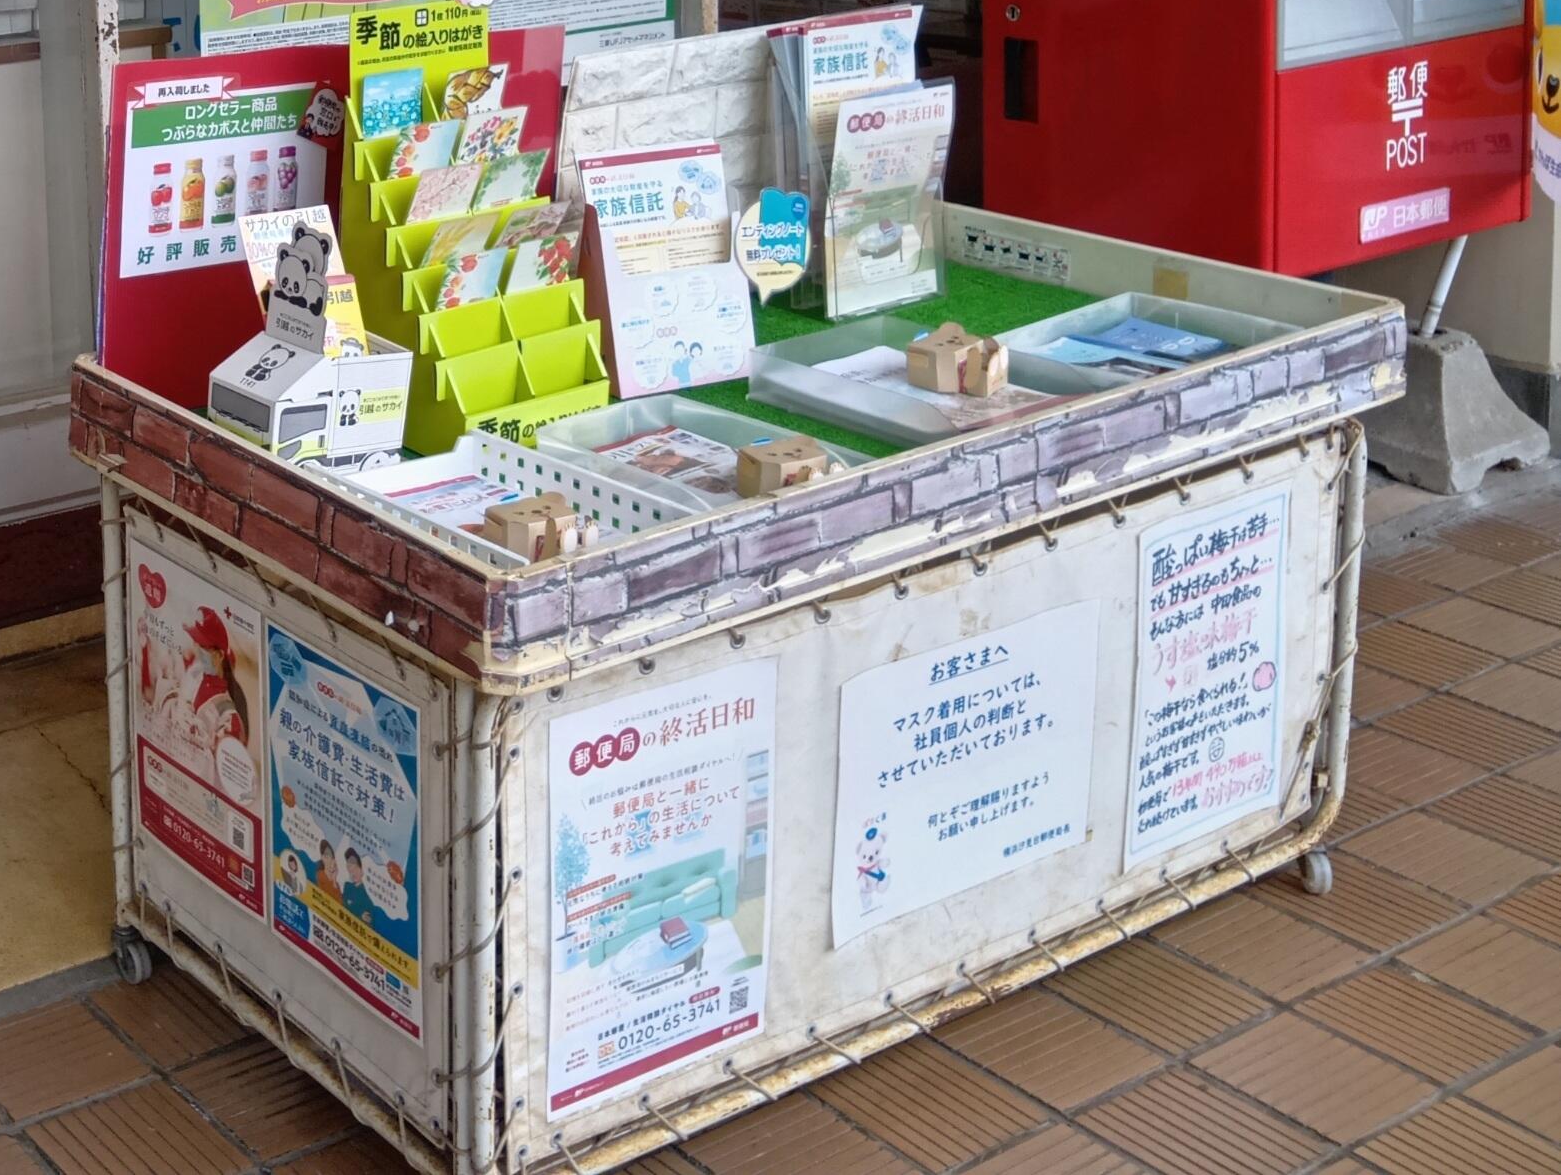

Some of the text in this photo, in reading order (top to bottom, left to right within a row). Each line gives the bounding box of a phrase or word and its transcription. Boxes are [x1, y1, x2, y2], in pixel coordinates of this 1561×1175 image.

[356, 14, 485, 52] 季節の絵入りはがき
[813, 50, 869, 76] 家族信託
[1387, 60, 1429, 105] 郵便
[158, 84, 211, 98] 再入荷しました
[185, 96, 278, 121] ロングセラー商品
[161, 112, 298, 143] つぶらなカボスと仲間たち
[1386, 131, 1428, 172] POST
[593, 190, 665, 220] 家族信託
[1393, 193, 1450, 230] 日本郵便
[137, 235, 237, 266] 好評販売
[359, 399, 405, 417] 引越のサカイ
[929, 644, 1009, 683] お客さまへ
[893, 672, 1041, 733] マスク着用については、
[573, 696, 756, 771] 郵便局の終活日和
[913, 699, 1027, 752] 社員個人の判断と
[279, 707, 406, 803] 親の介護費・生活費は
[877, 713, 1054, 789] させていただいております。
[288, 739, 395, 825] 家族信託で対策!
[612, 777, 710, 820] 郵便局と一緒に
[927, 771, 1051, 830] 何とぞご理解賜りますよう
[582, 785, 740, 846] 「これから」の生活について
[609, 814, 713, 858] 考えてみませんか
[937, 796, 1035, 842] お願い申し上げます。
[1002, 823, 1072, 859] 横浜汐見台郵便局長
[617, 998, 721, 1050] 0120-65-3741
